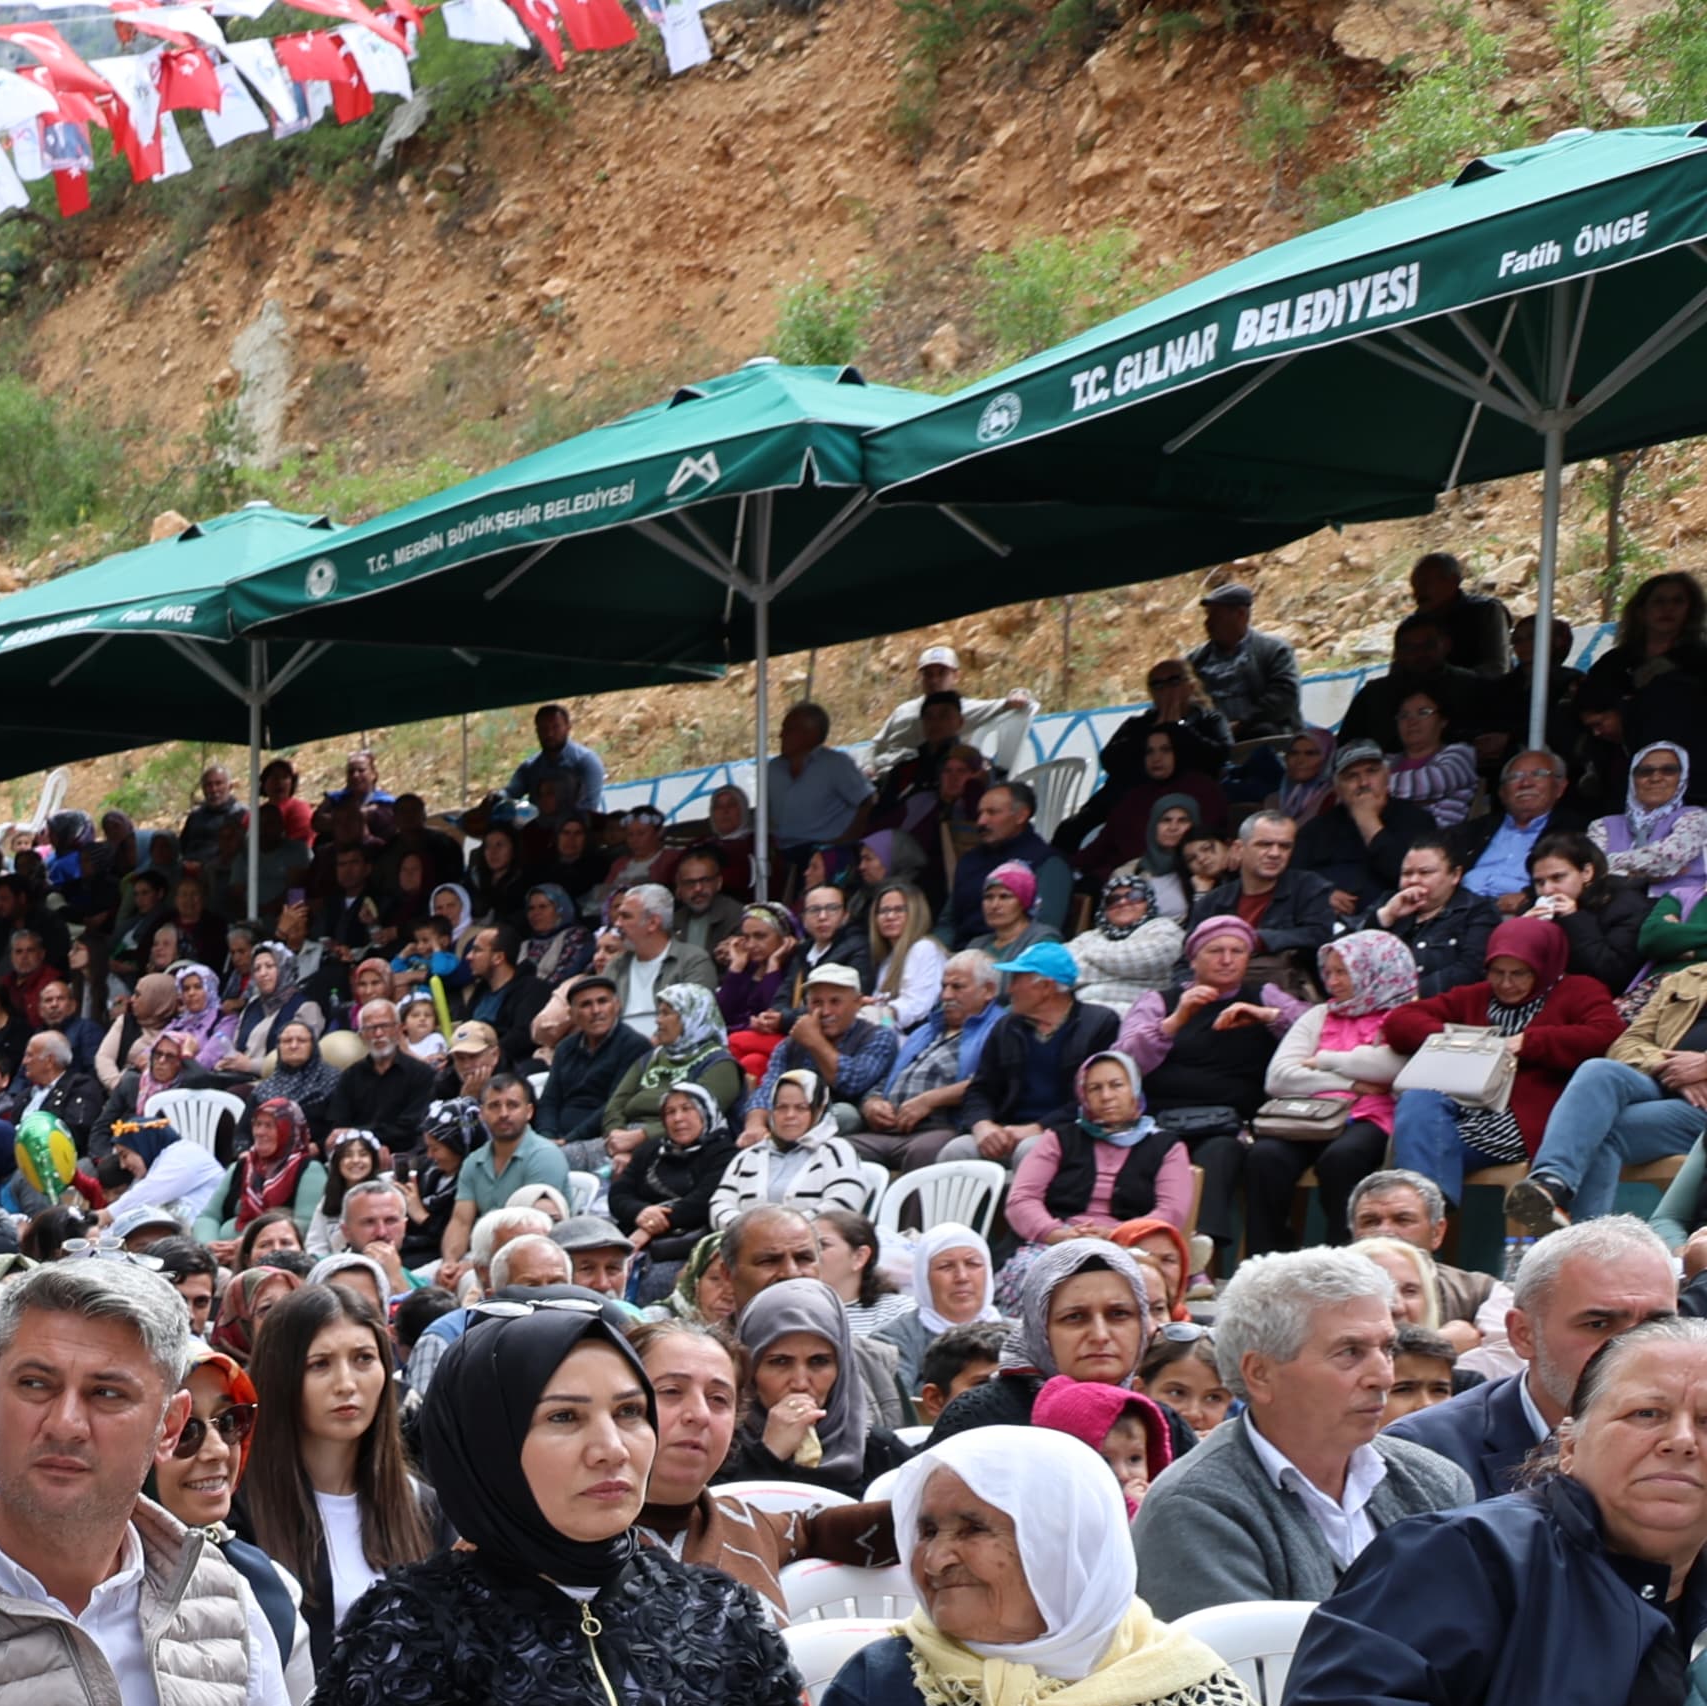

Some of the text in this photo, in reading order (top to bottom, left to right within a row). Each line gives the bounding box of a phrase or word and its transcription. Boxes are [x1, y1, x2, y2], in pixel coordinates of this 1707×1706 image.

[1070, 364, 1111, 412] T.C.
[1498, 240, 1562, 278] Fatih
[1574, 210, 1650, 257] ÖNGE
[367, 479, 635, 575] T.C. MERSİN BÜYÜKŞEHİR BELEDİYESİ
